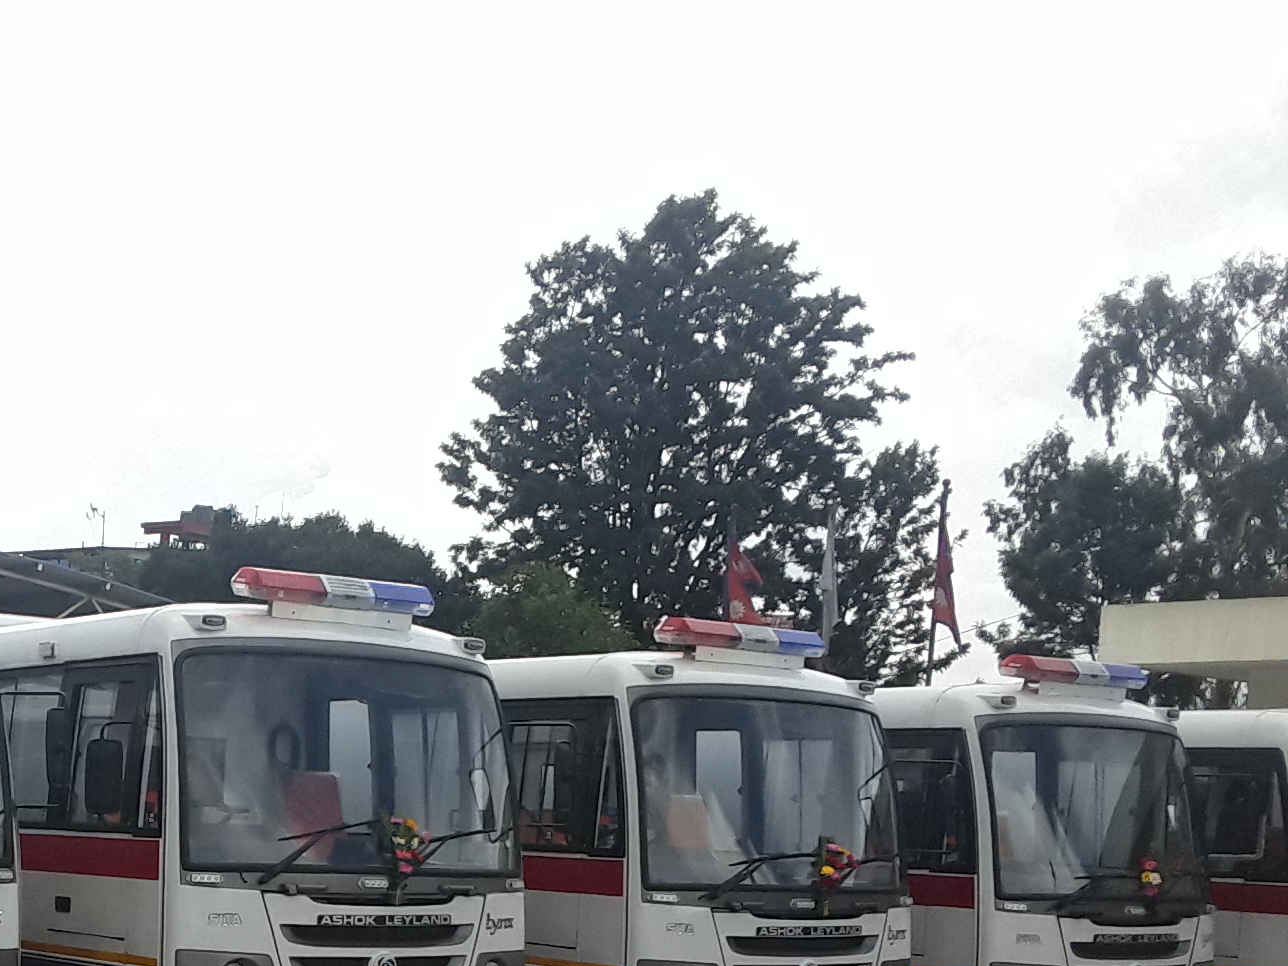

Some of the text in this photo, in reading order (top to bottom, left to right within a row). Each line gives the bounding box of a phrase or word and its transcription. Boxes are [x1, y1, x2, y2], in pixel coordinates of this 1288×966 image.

[321, 915, 450, 925] ASHOK LEYLAND
[759, 926, 861, 936] ASHOK LEYLAND
